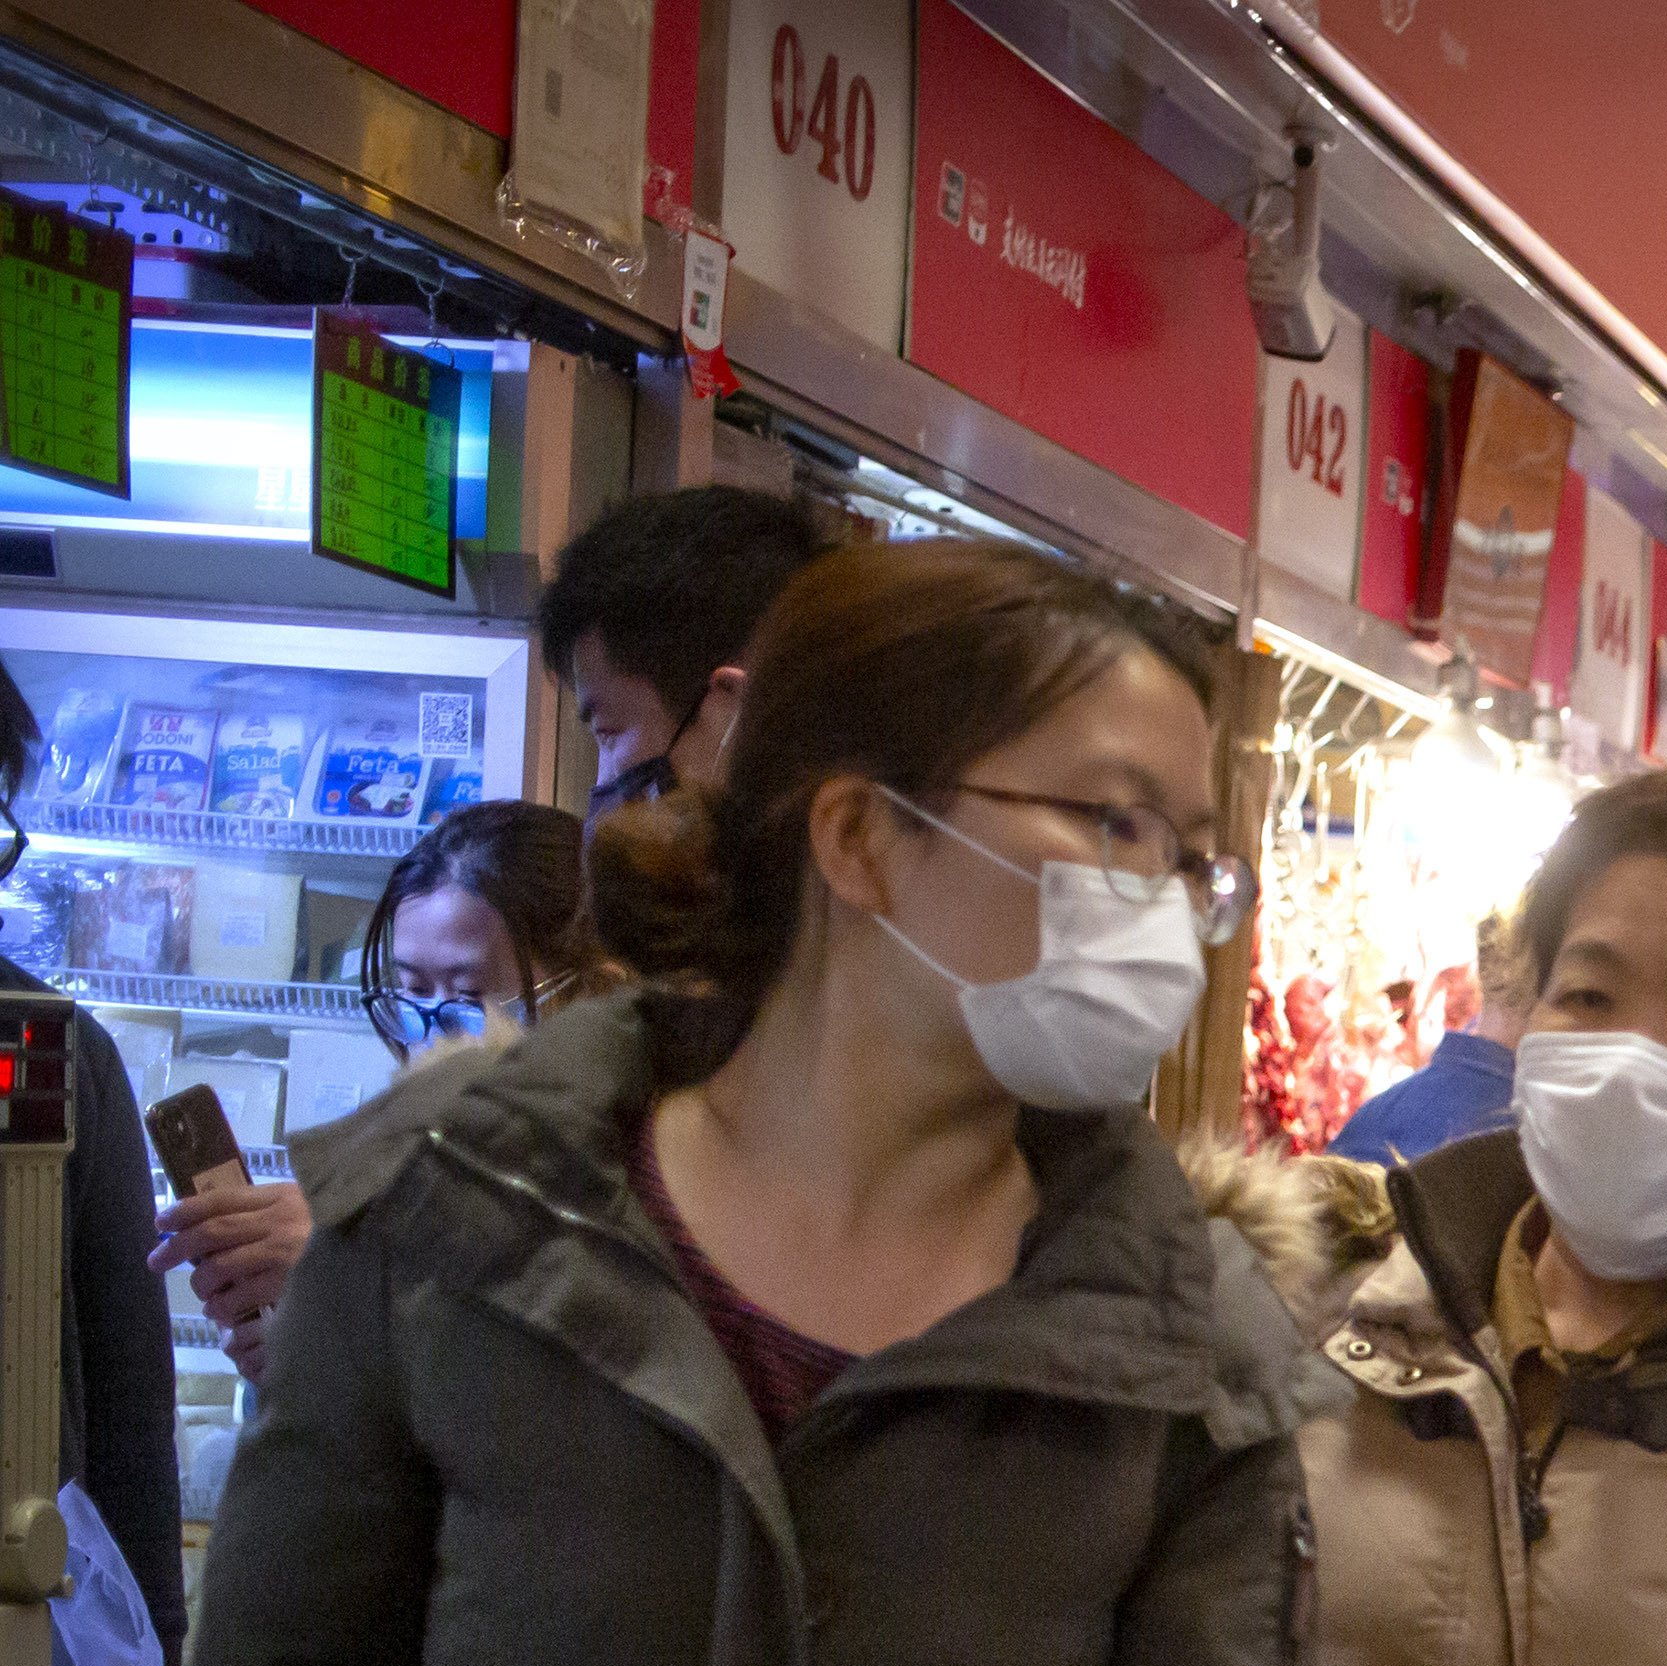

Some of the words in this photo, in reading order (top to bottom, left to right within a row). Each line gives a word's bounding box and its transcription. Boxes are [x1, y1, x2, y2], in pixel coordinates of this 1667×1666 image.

[771, 23, 876, 202] 040
[1285, 378, 1346, 498] 042
[134, 755, 184, 772] FETA
[227, 754, 282, 771] Salad
[347, 754, 401, 774] Feta
